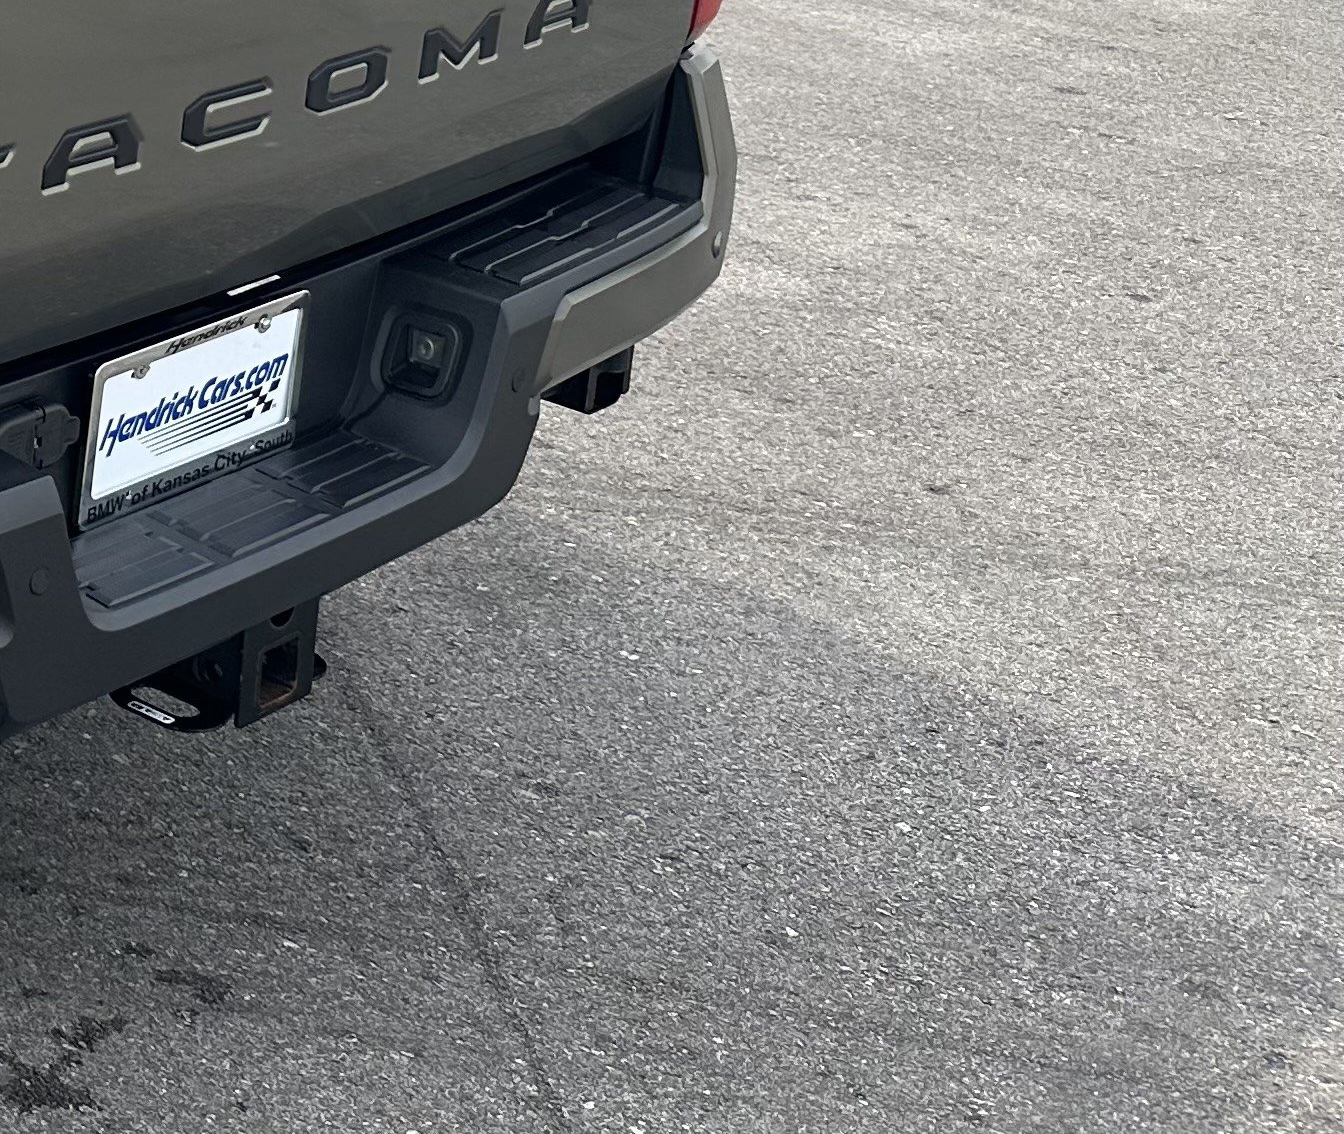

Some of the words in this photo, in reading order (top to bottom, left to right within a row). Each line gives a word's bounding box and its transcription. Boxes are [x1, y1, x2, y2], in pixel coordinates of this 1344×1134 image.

[165, 316, 248, 354] Hendrick
[86, 493, 127, 524] BMW
[131, 484, 154, 506] of
[151, 464, 211, 498] Kansas
[214, 449, 248, 472] City
[254, 429, 293, 456] South
